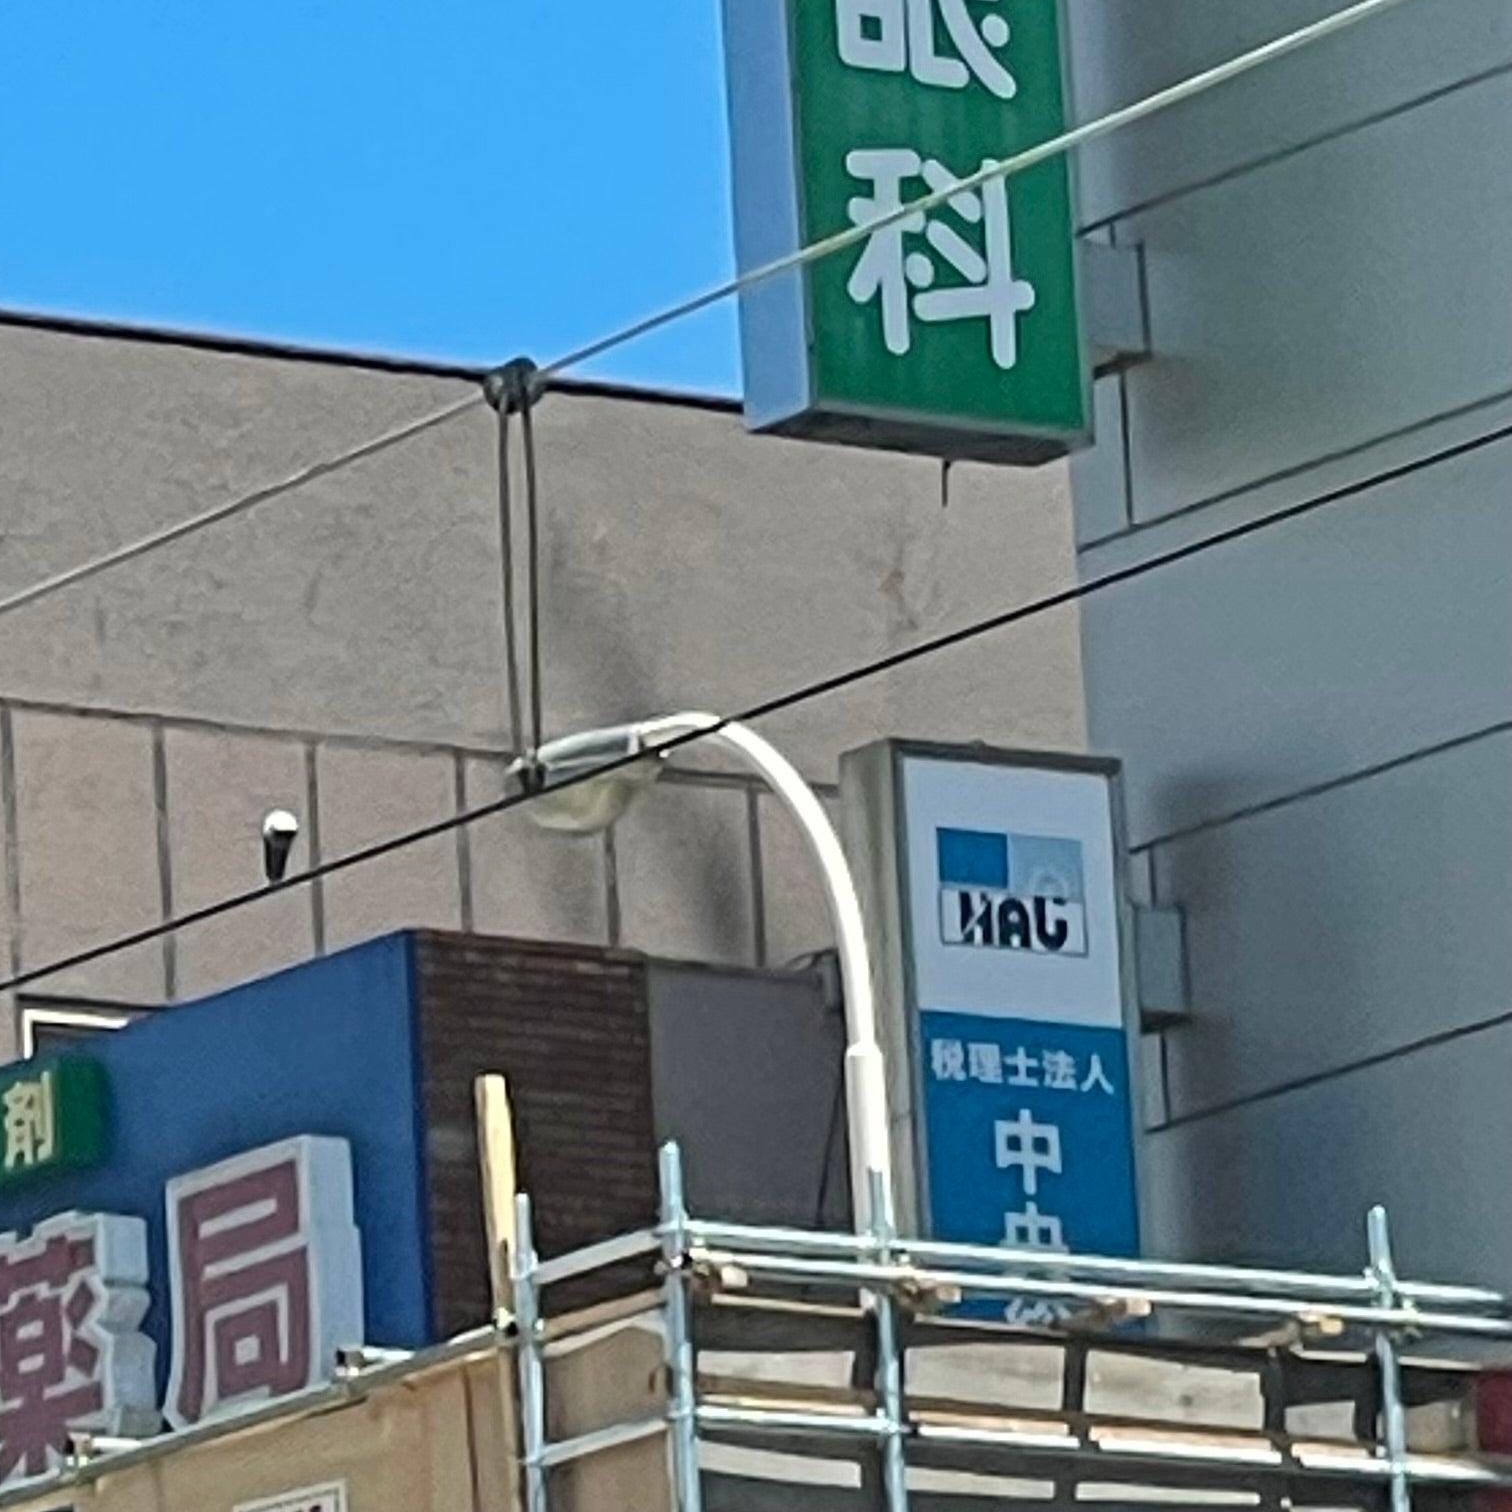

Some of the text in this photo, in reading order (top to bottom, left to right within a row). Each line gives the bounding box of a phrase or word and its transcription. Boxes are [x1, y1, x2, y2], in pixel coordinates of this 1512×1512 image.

[931, 1038, 1115, 1095] 税理士法人
